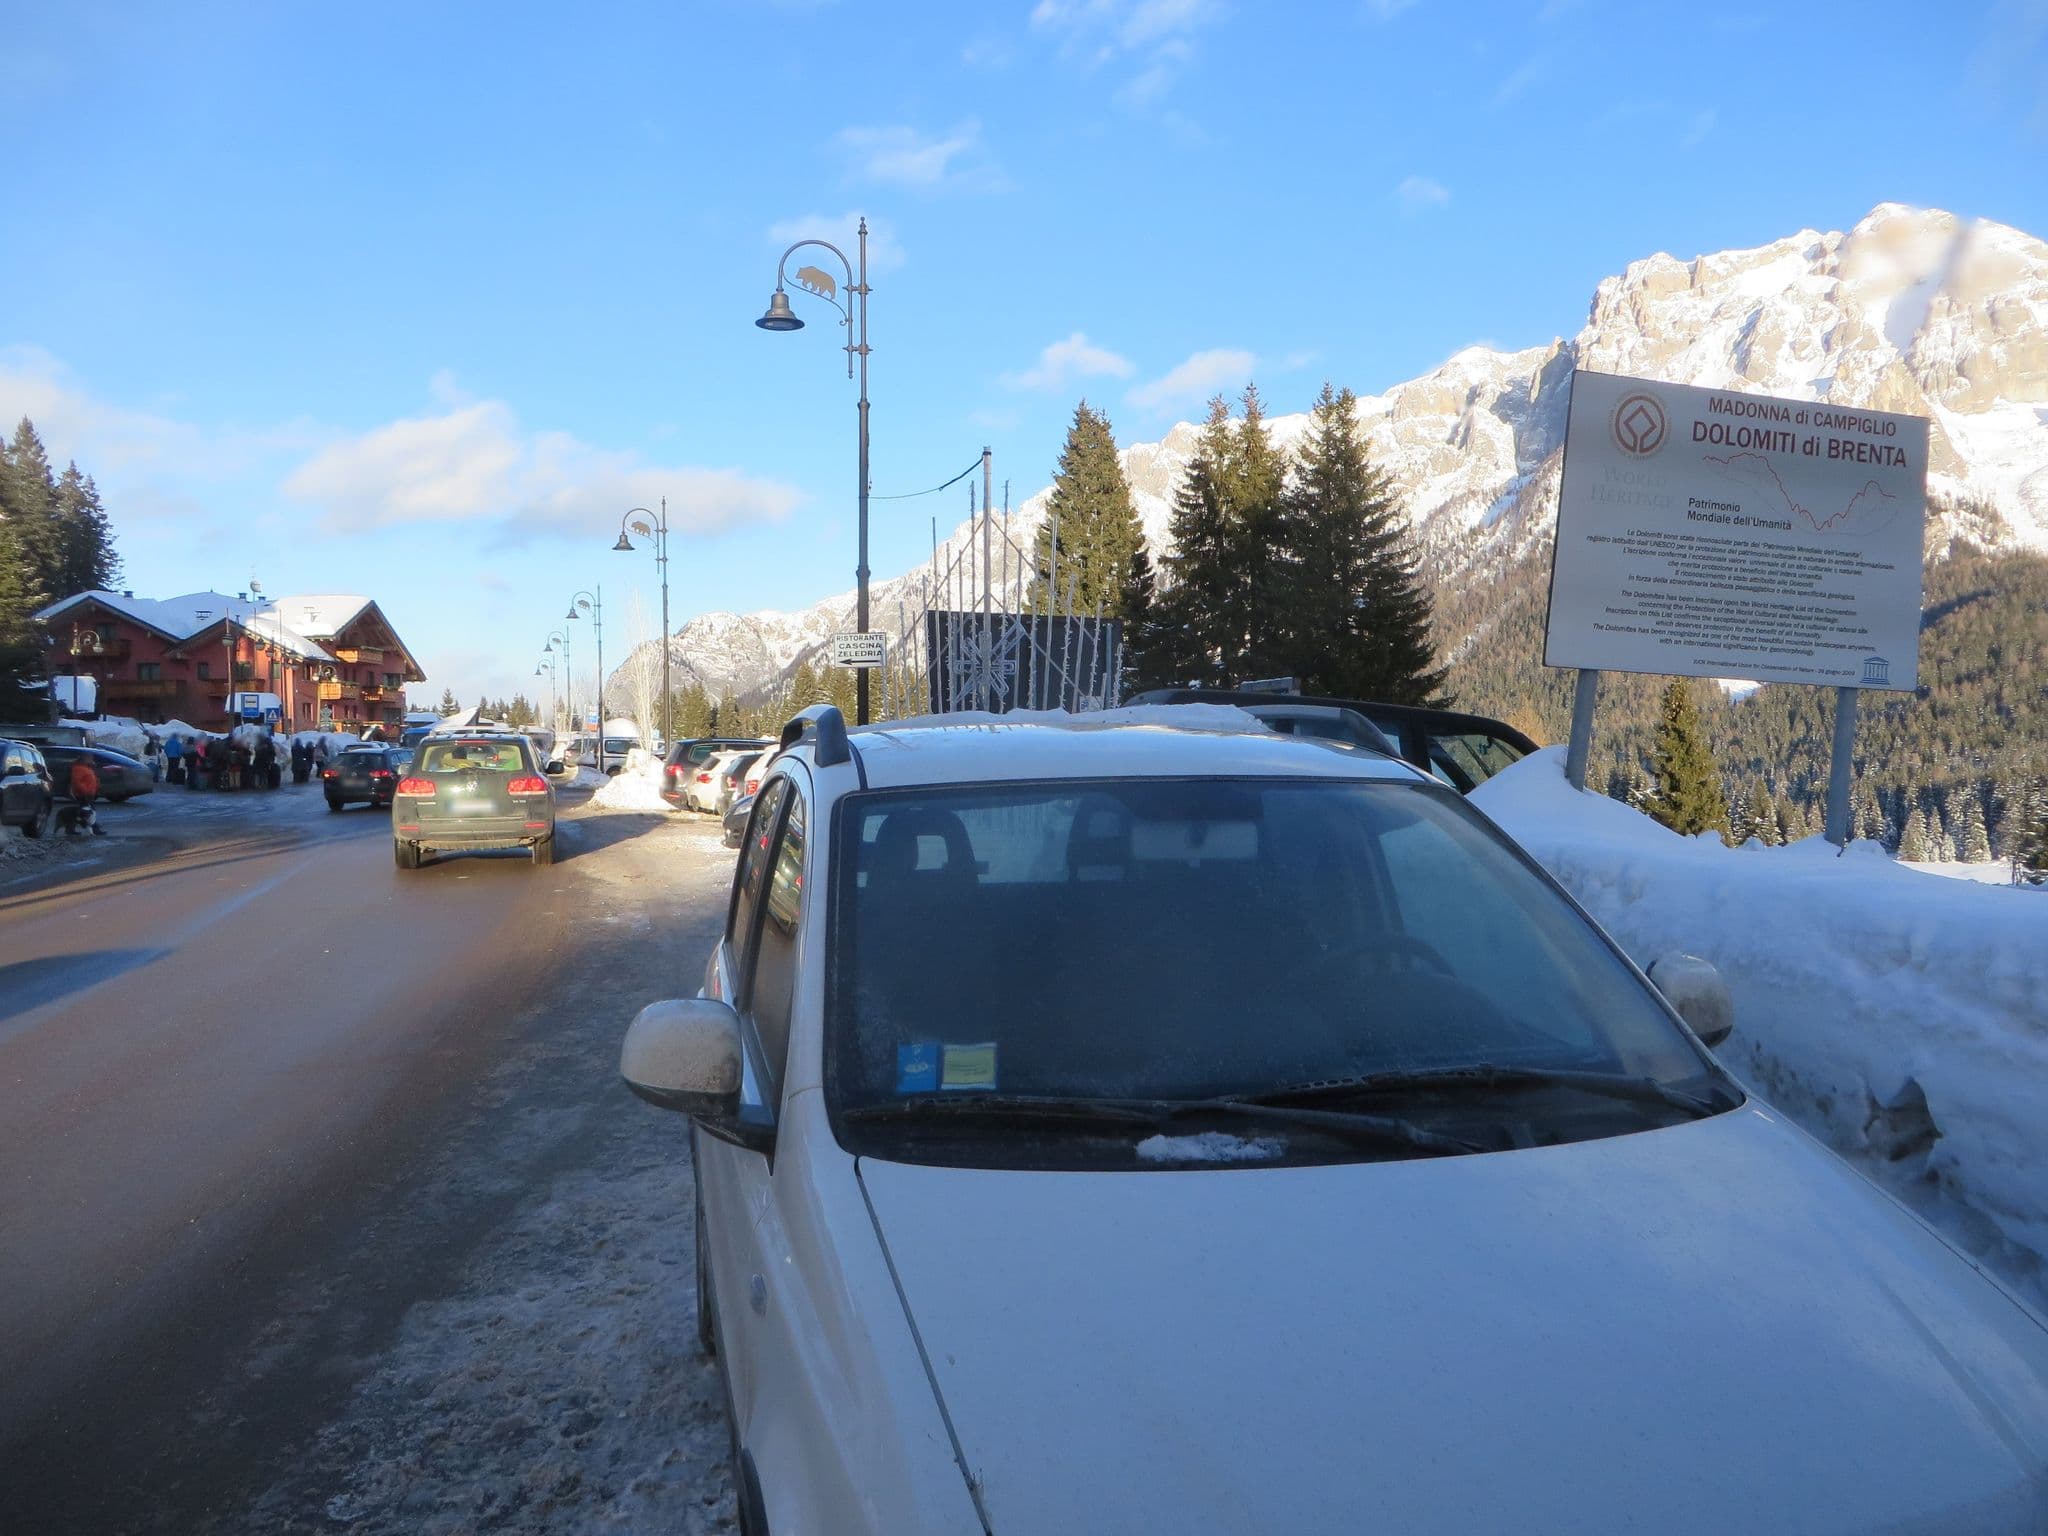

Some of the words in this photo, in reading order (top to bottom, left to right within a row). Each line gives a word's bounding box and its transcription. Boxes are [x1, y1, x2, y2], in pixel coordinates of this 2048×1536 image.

[1708, 397, 1790, 422] MADONNA
[1795, 409, 1808, 425] di
[1813, 411, 1896, 436] CAMPIGLIO
[1692, 420, 1795, 454] DOLOMITI
[1802, 434, 1820, 457] di
[1827, 437, 1906, 467] BRENTA
[1688, 497, 1740, 512] Patrimonio
[1687, 510, 1730, 524] Mondiale
[1732, 514, 1791, 530] dell'Umanità
